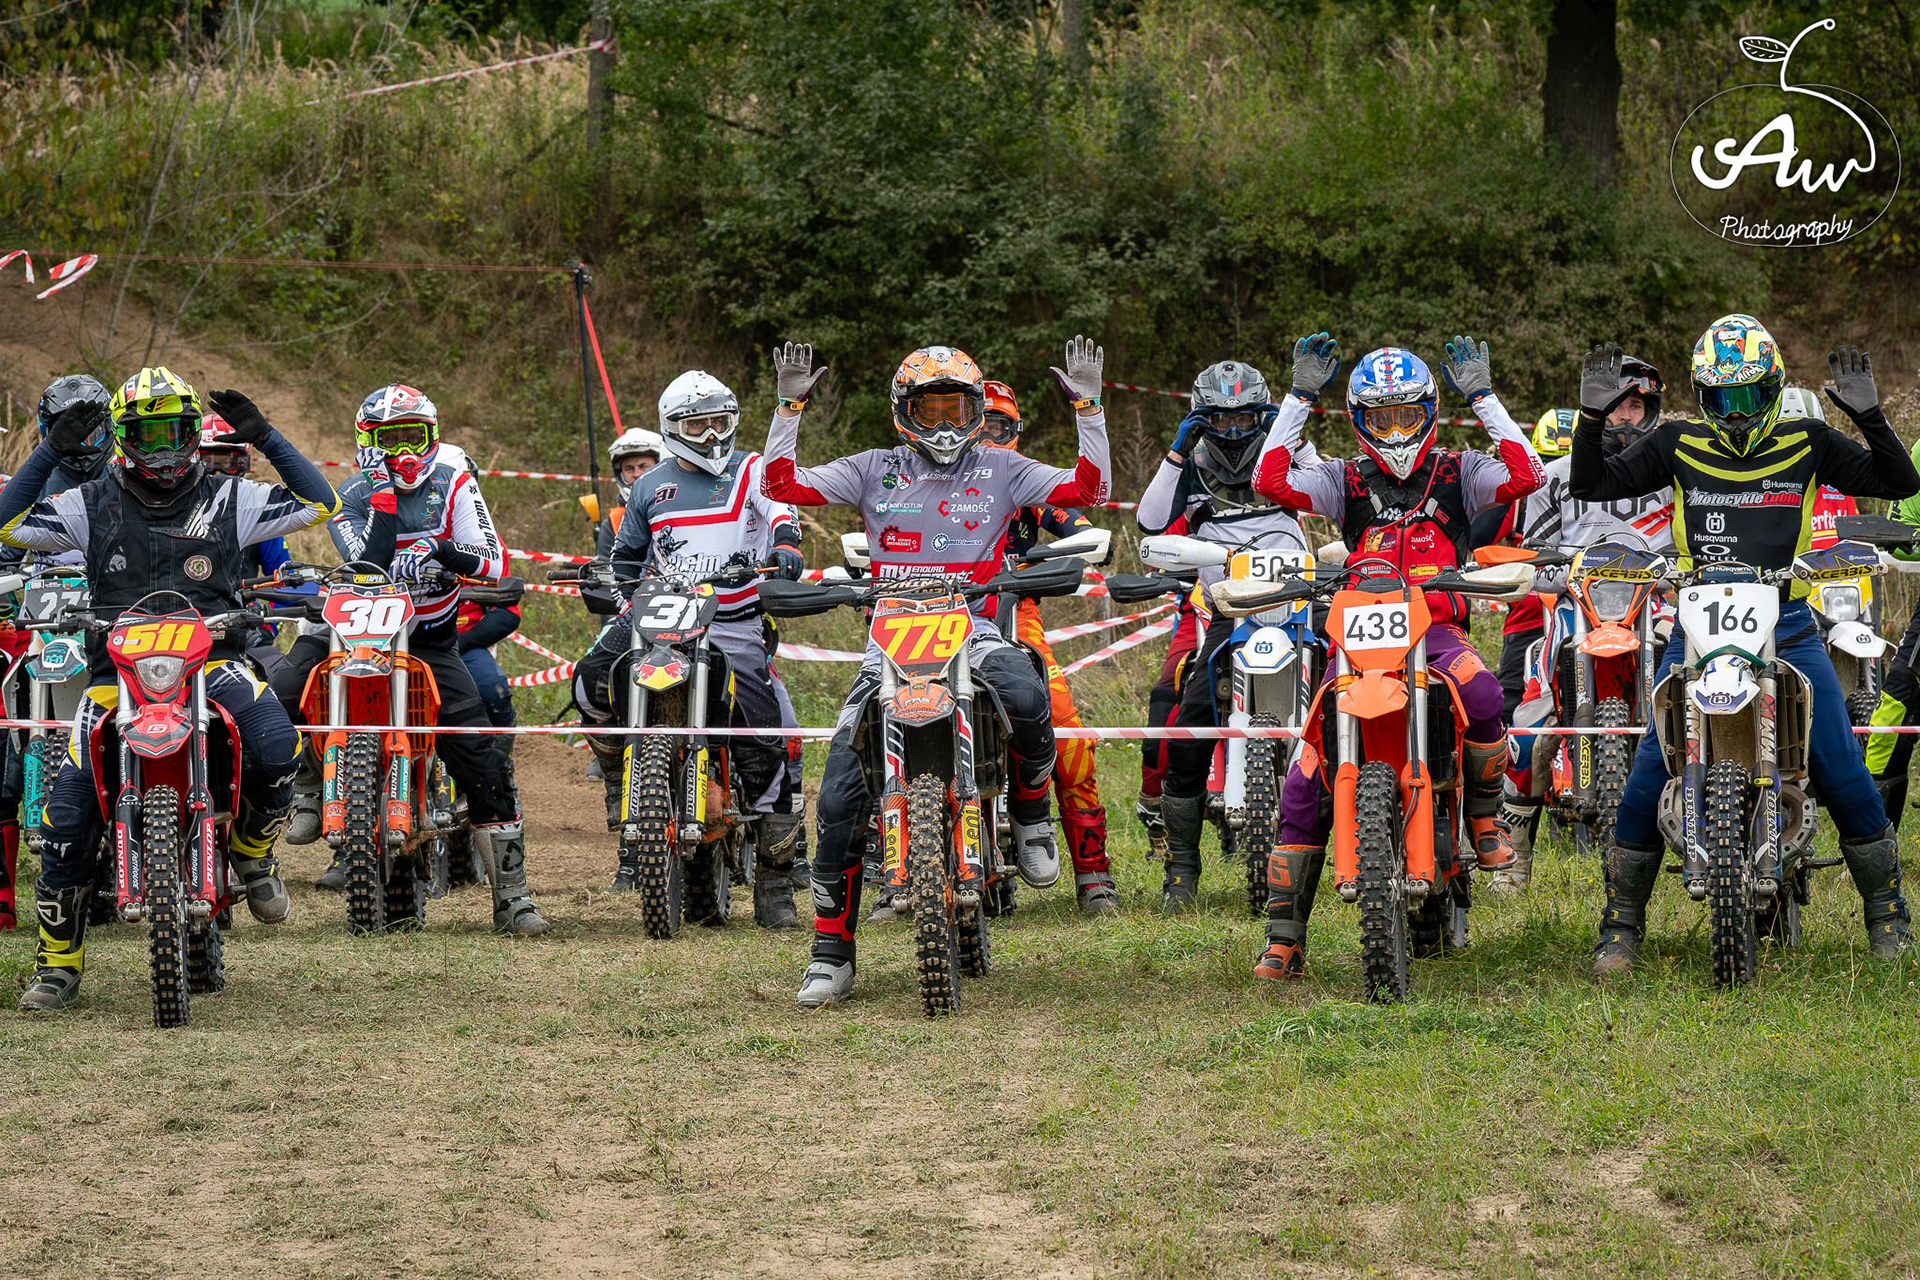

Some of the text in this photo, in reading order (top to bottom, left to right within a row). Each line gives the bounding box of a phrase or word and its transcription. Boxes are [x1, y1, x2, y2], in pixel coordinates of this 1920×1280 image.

[963, 468, 993, 482] 779
[1771, 481, 1803, 490] Husqvarna
[655, 486, 678, 506] 31
[951, 501, 990, 513] ZAMOŚĆ
[474, 500, 492, 531] Team
[1694, 533, 1738, 543] Husqvarna
[911, 565, 945, 573] ENDURO
[1587, 567, 1654, 580] ACERBIS
[1810, 564, 1874, 580] ACERBIS
[335, 598, 407, 636] 30
[639, 594, 707, 630] 31
[1346, 610, 1408, 642] 438
[1703, 601, 1758, 636] 166
[122, 623, 196, 655] 511
[884, 613, 969, 661] 779
[336, 748, 345, 801] DUNLOP
[390, 760, 399, 799] DUNLOP
[1580, 735, 1591, 789] ACERBIS
[630, 758, 641, 817] DUNLOP
[686, 759, 696, 816] DUNLOP
[1685, 787, 1697, 862] DUNLOP
[1767, 791, 1778, 861] DUNLOP
[117, 828, 125, 889] DUNLOP
[206, 822, 214, 886] DUNLOP
[886, 833, 899, 869] eni
[131, 849, 139, 891] FASTHOUSE
